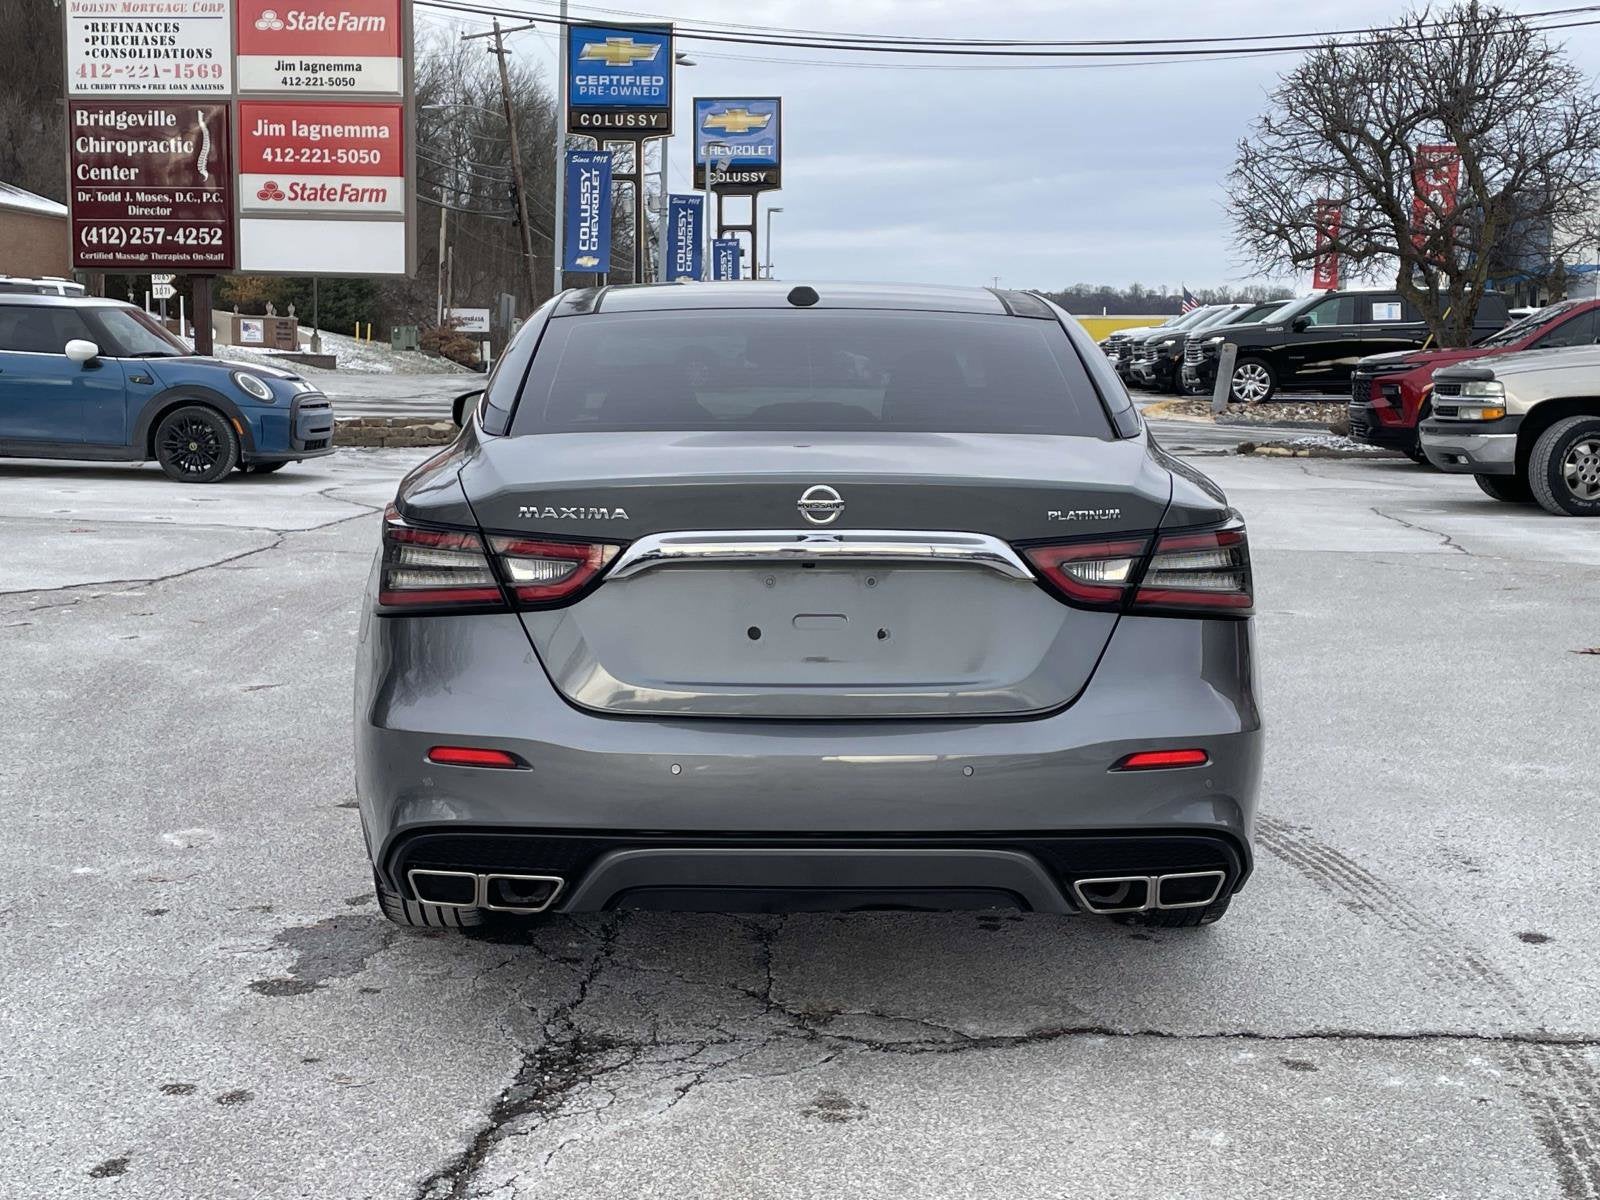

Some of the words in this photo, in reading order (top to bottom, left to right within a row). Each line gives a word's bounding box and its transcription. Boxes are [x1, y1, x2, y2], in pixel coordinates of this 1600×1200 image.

[121, 2, 187, 13] MORTGAGE
[192, 2, 225, 13] CORP.
[91, 22, 180, 33] REFINANCES
[91, 35, 176, 46] PURCHASES
[92, 48, 213, 59] CONSOLIDATIONS
[76, 63, 223, 79] 412-221-1569
[274, 60, 296, 72] Jim
[299, 61, 363, 74] Iagnemma
[281, 77, 356, 87] 412-221-5050
[575, 75, 664, 86] CERTIFIED
[579, 86, 660, 96] PRE-OWNED
[75, 110, 177, 131] Bridgeville
[580, 114, 658, 126] COLUSSY
[252, 119, 286, 137] Jim
[291, 120, 390, 141] Iagnemma
[75, 136, 194, 157] Chiropractic
[701, 145, 774, 156] CHEVROLET
[262, 148, 381, 165] 412-221-5050
[572, 155, 590, 163] Since
[592, 155, 609, 163] 1918
[76, 163, 139, 181] Center
[709, 172, 767, 184] COLUSSY
[77, 192, 94, 202] Dr.
[96, 192, 121, 202] Todd
[124, 192, 133, 202] J.
[135, 192, 173, 204] Moses,
[202, 193, 223, 203] P.C.
[127, 205, 173, 216] Director
[579, 168, 591, 251] COLUSSY
[590, 168, 600, 251] CHEVROLET
[677, 208, 687, 272] COLUSSY
[686, 208, 694, 272] CHEVROLET
[80, 252, 113, 260] Certified
[115, 252, 149, 261] Massage
[151, 253, 191, 262] Therapists
[192, 253, 225, 261] On-Staff
[518, 506, 629, 520] MAXIMA
[1047, 508, 1121, 521] PLATINUM
